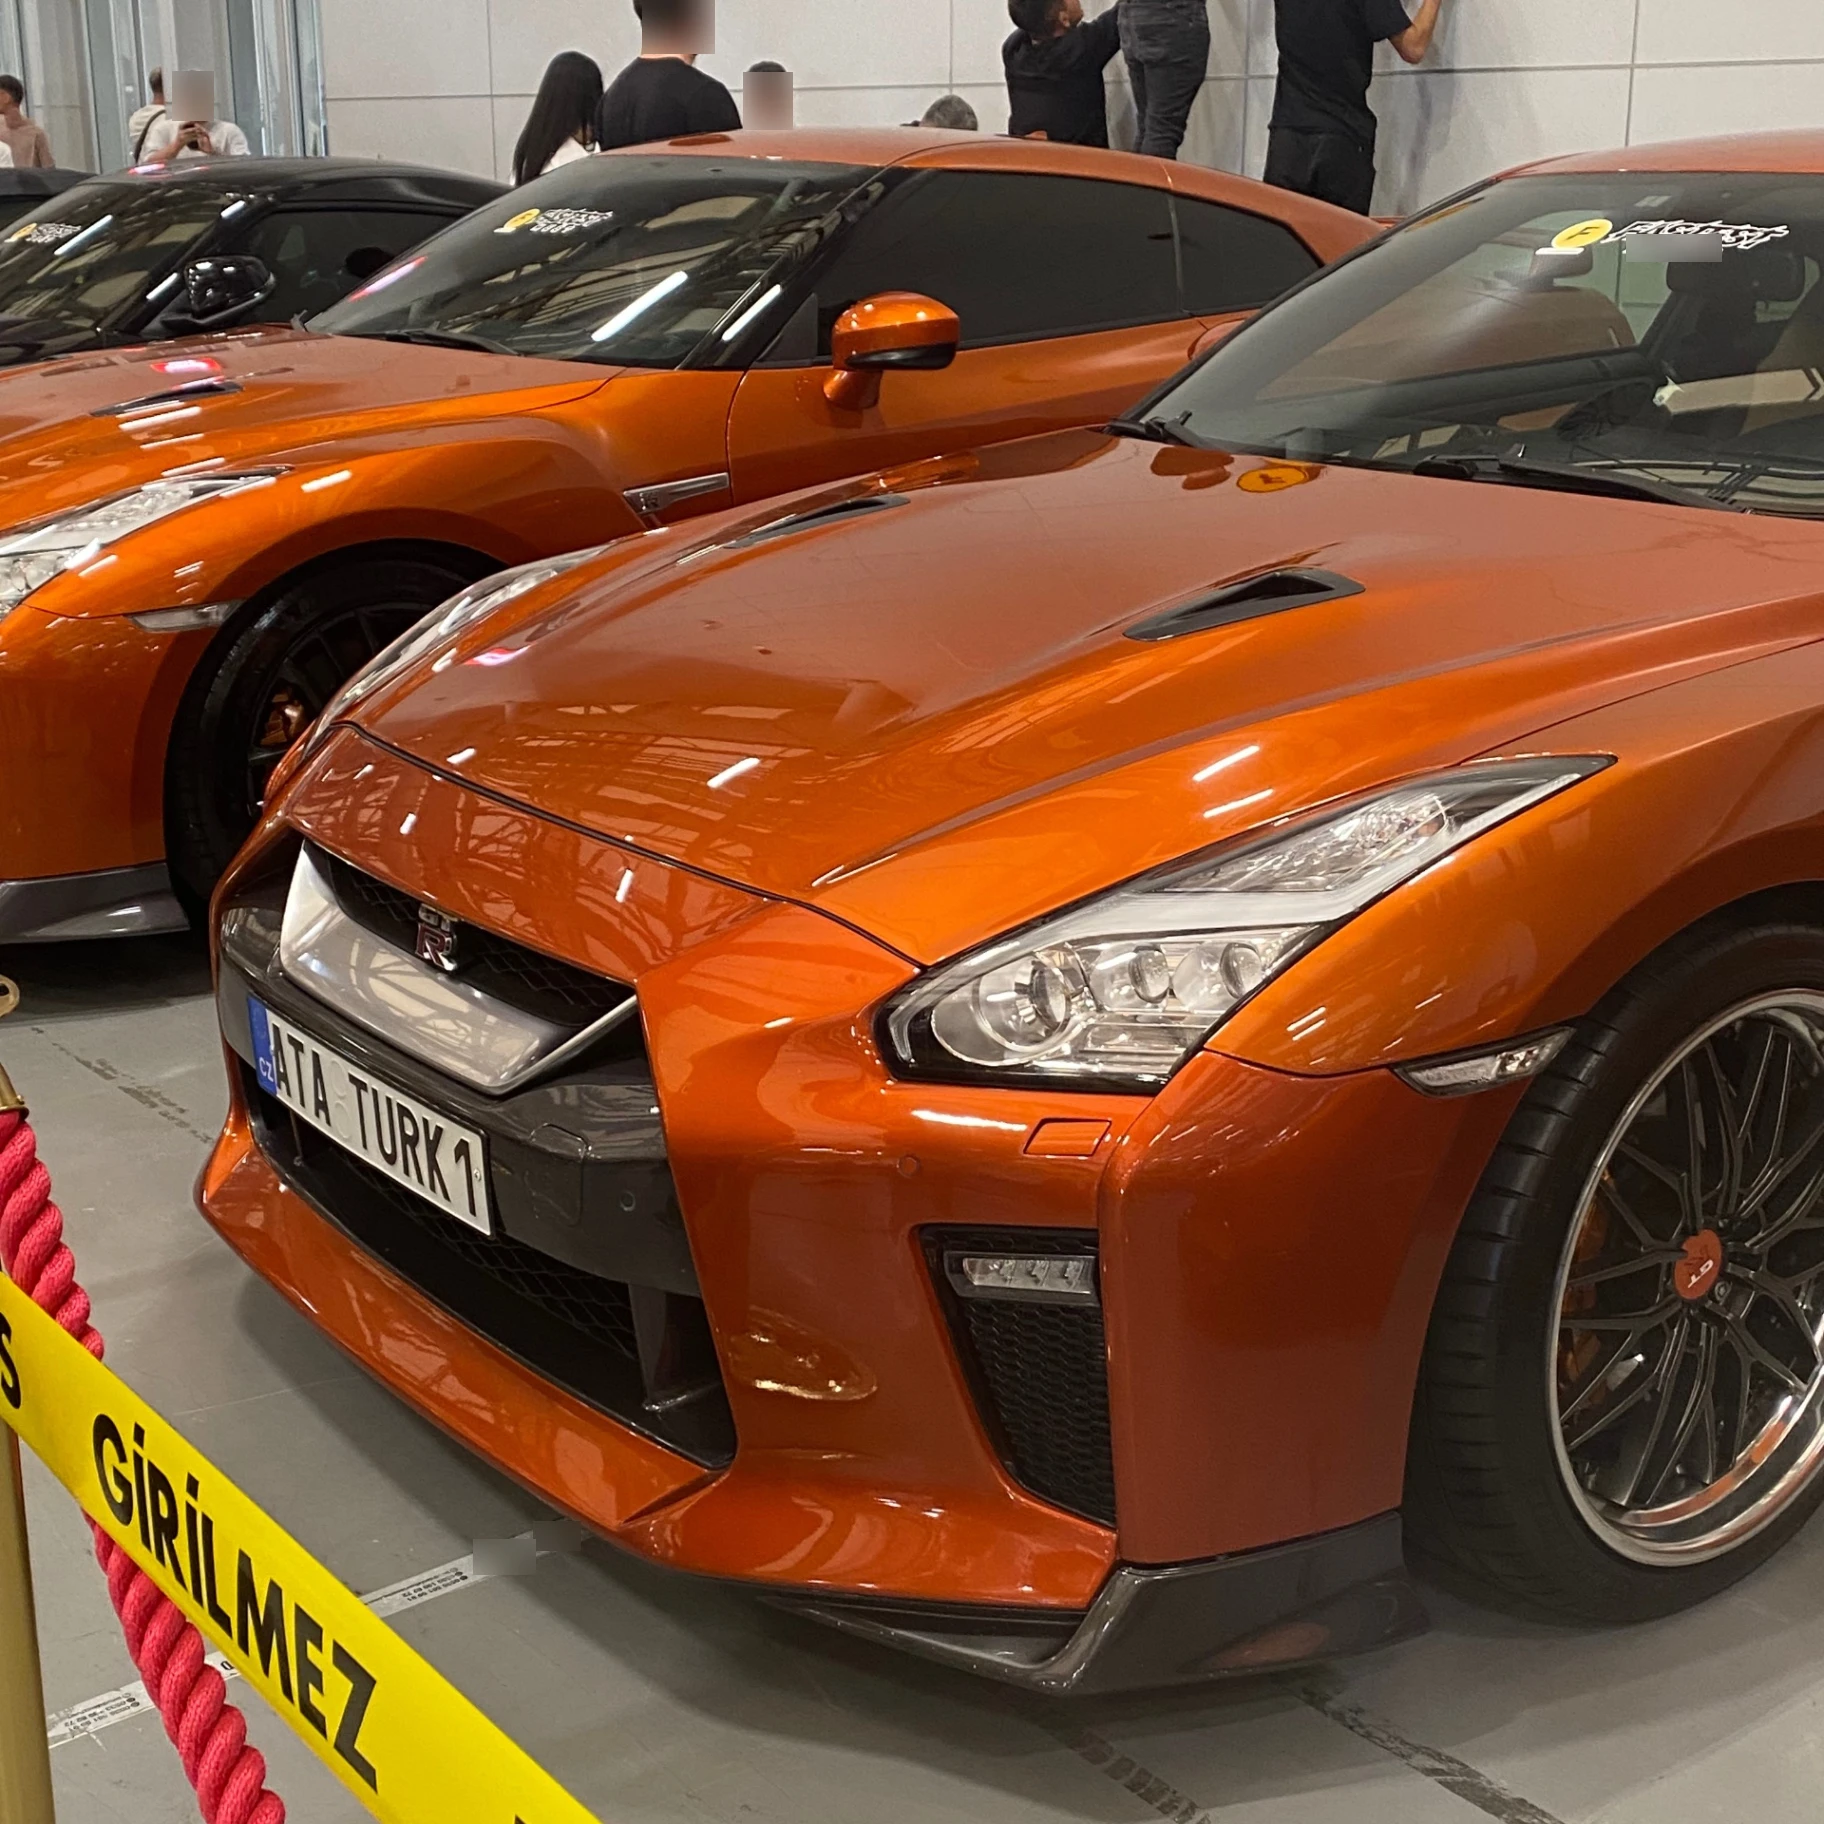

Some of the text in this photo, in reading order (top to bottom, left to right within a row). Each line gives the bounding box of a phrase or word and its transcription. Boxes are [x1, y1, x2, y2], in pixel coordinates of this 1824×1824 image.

[258, 1056, 275, 1083] CZ
[271, 1022, 477, 1218] ATA TURK 1
[91, 1413, 378, 1794] GİRİLMEZ
